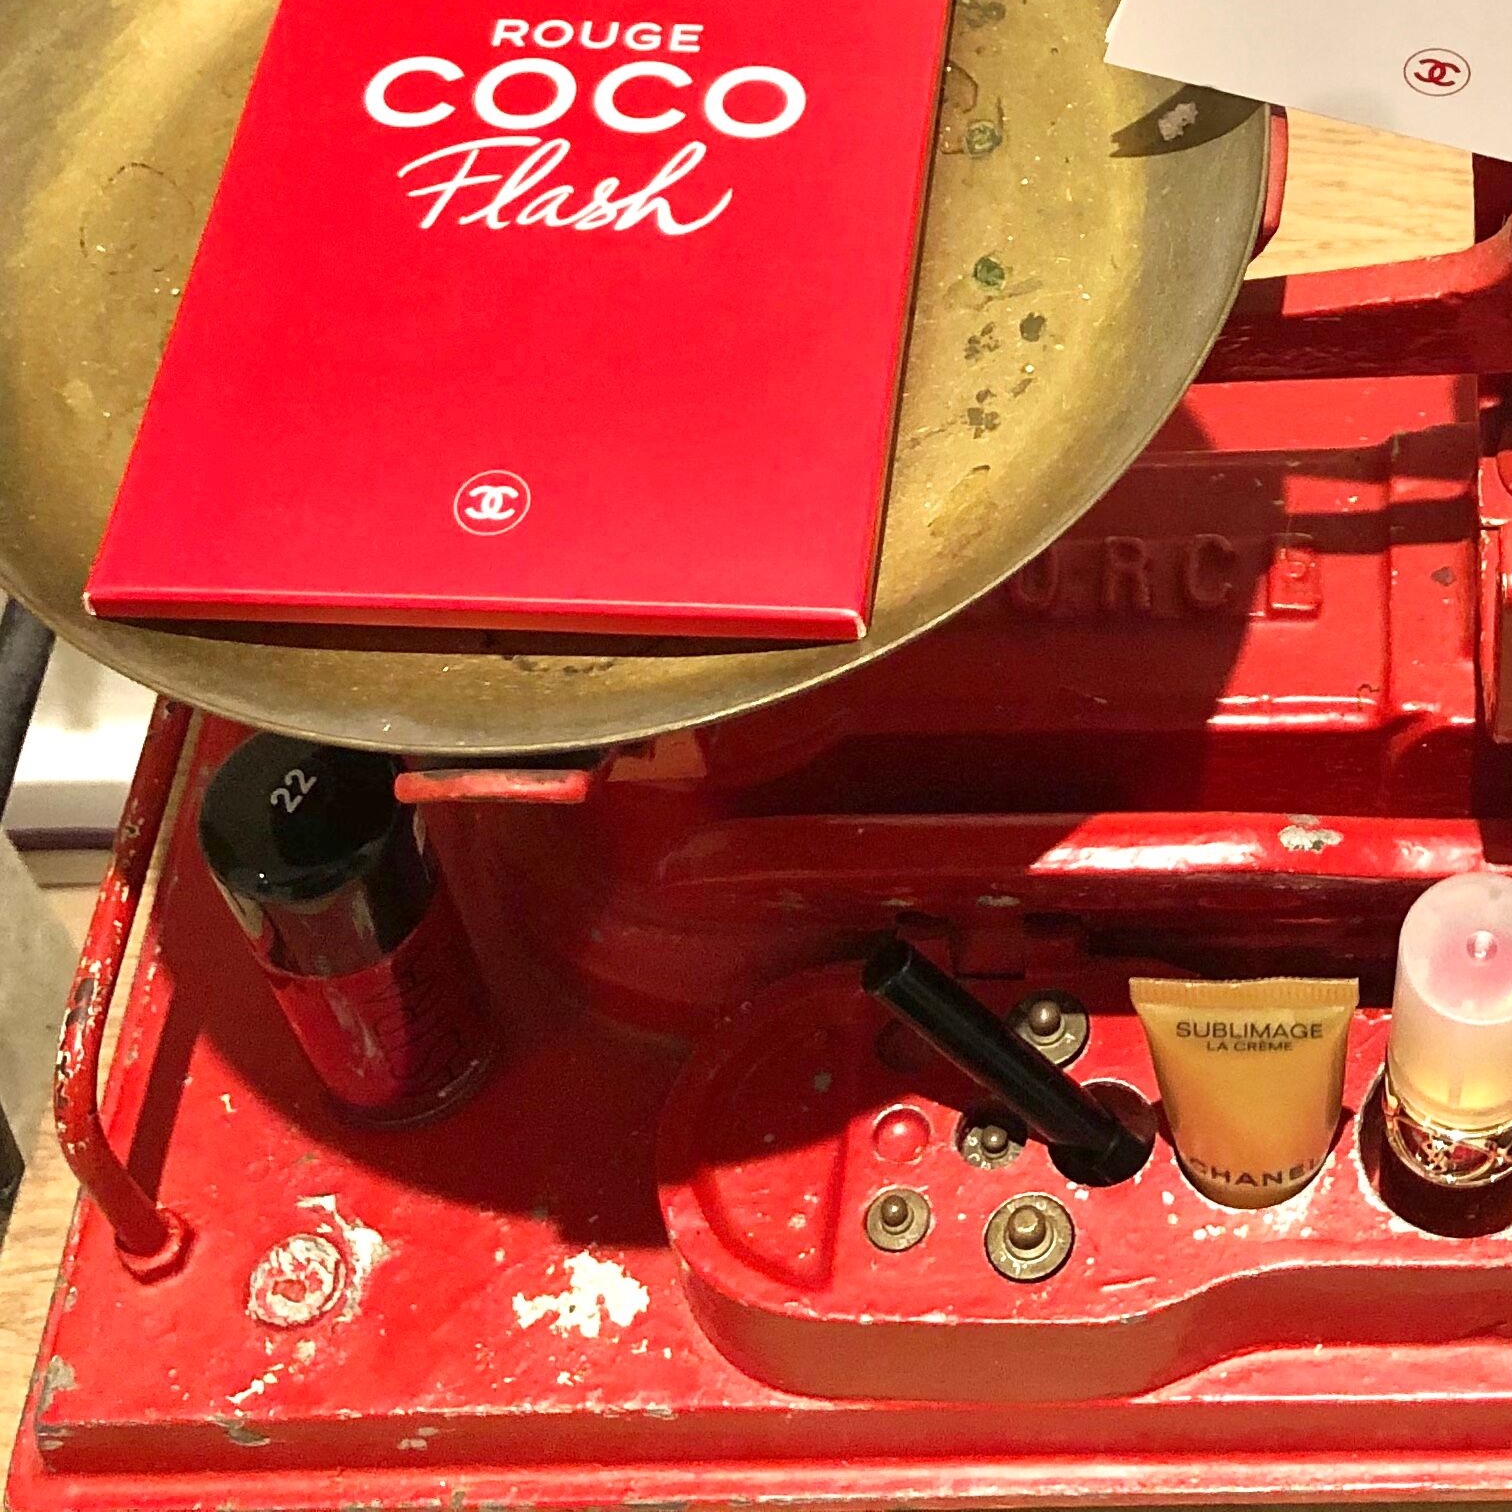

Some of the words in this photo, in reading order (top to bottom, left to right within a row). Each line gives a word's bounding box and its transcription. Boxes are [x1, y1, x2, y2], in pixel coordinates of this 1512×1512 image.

[490, 17, 706, 54] ROUGE
[362, 55, 808, 140] COCO
[396, 134, 734, 237] Flash
[269, 768, 318, 814] 22
[1175, 1020, 1324, 1040] SUBLIMAGE
[1206, 1041, 1229, 1053] LA
